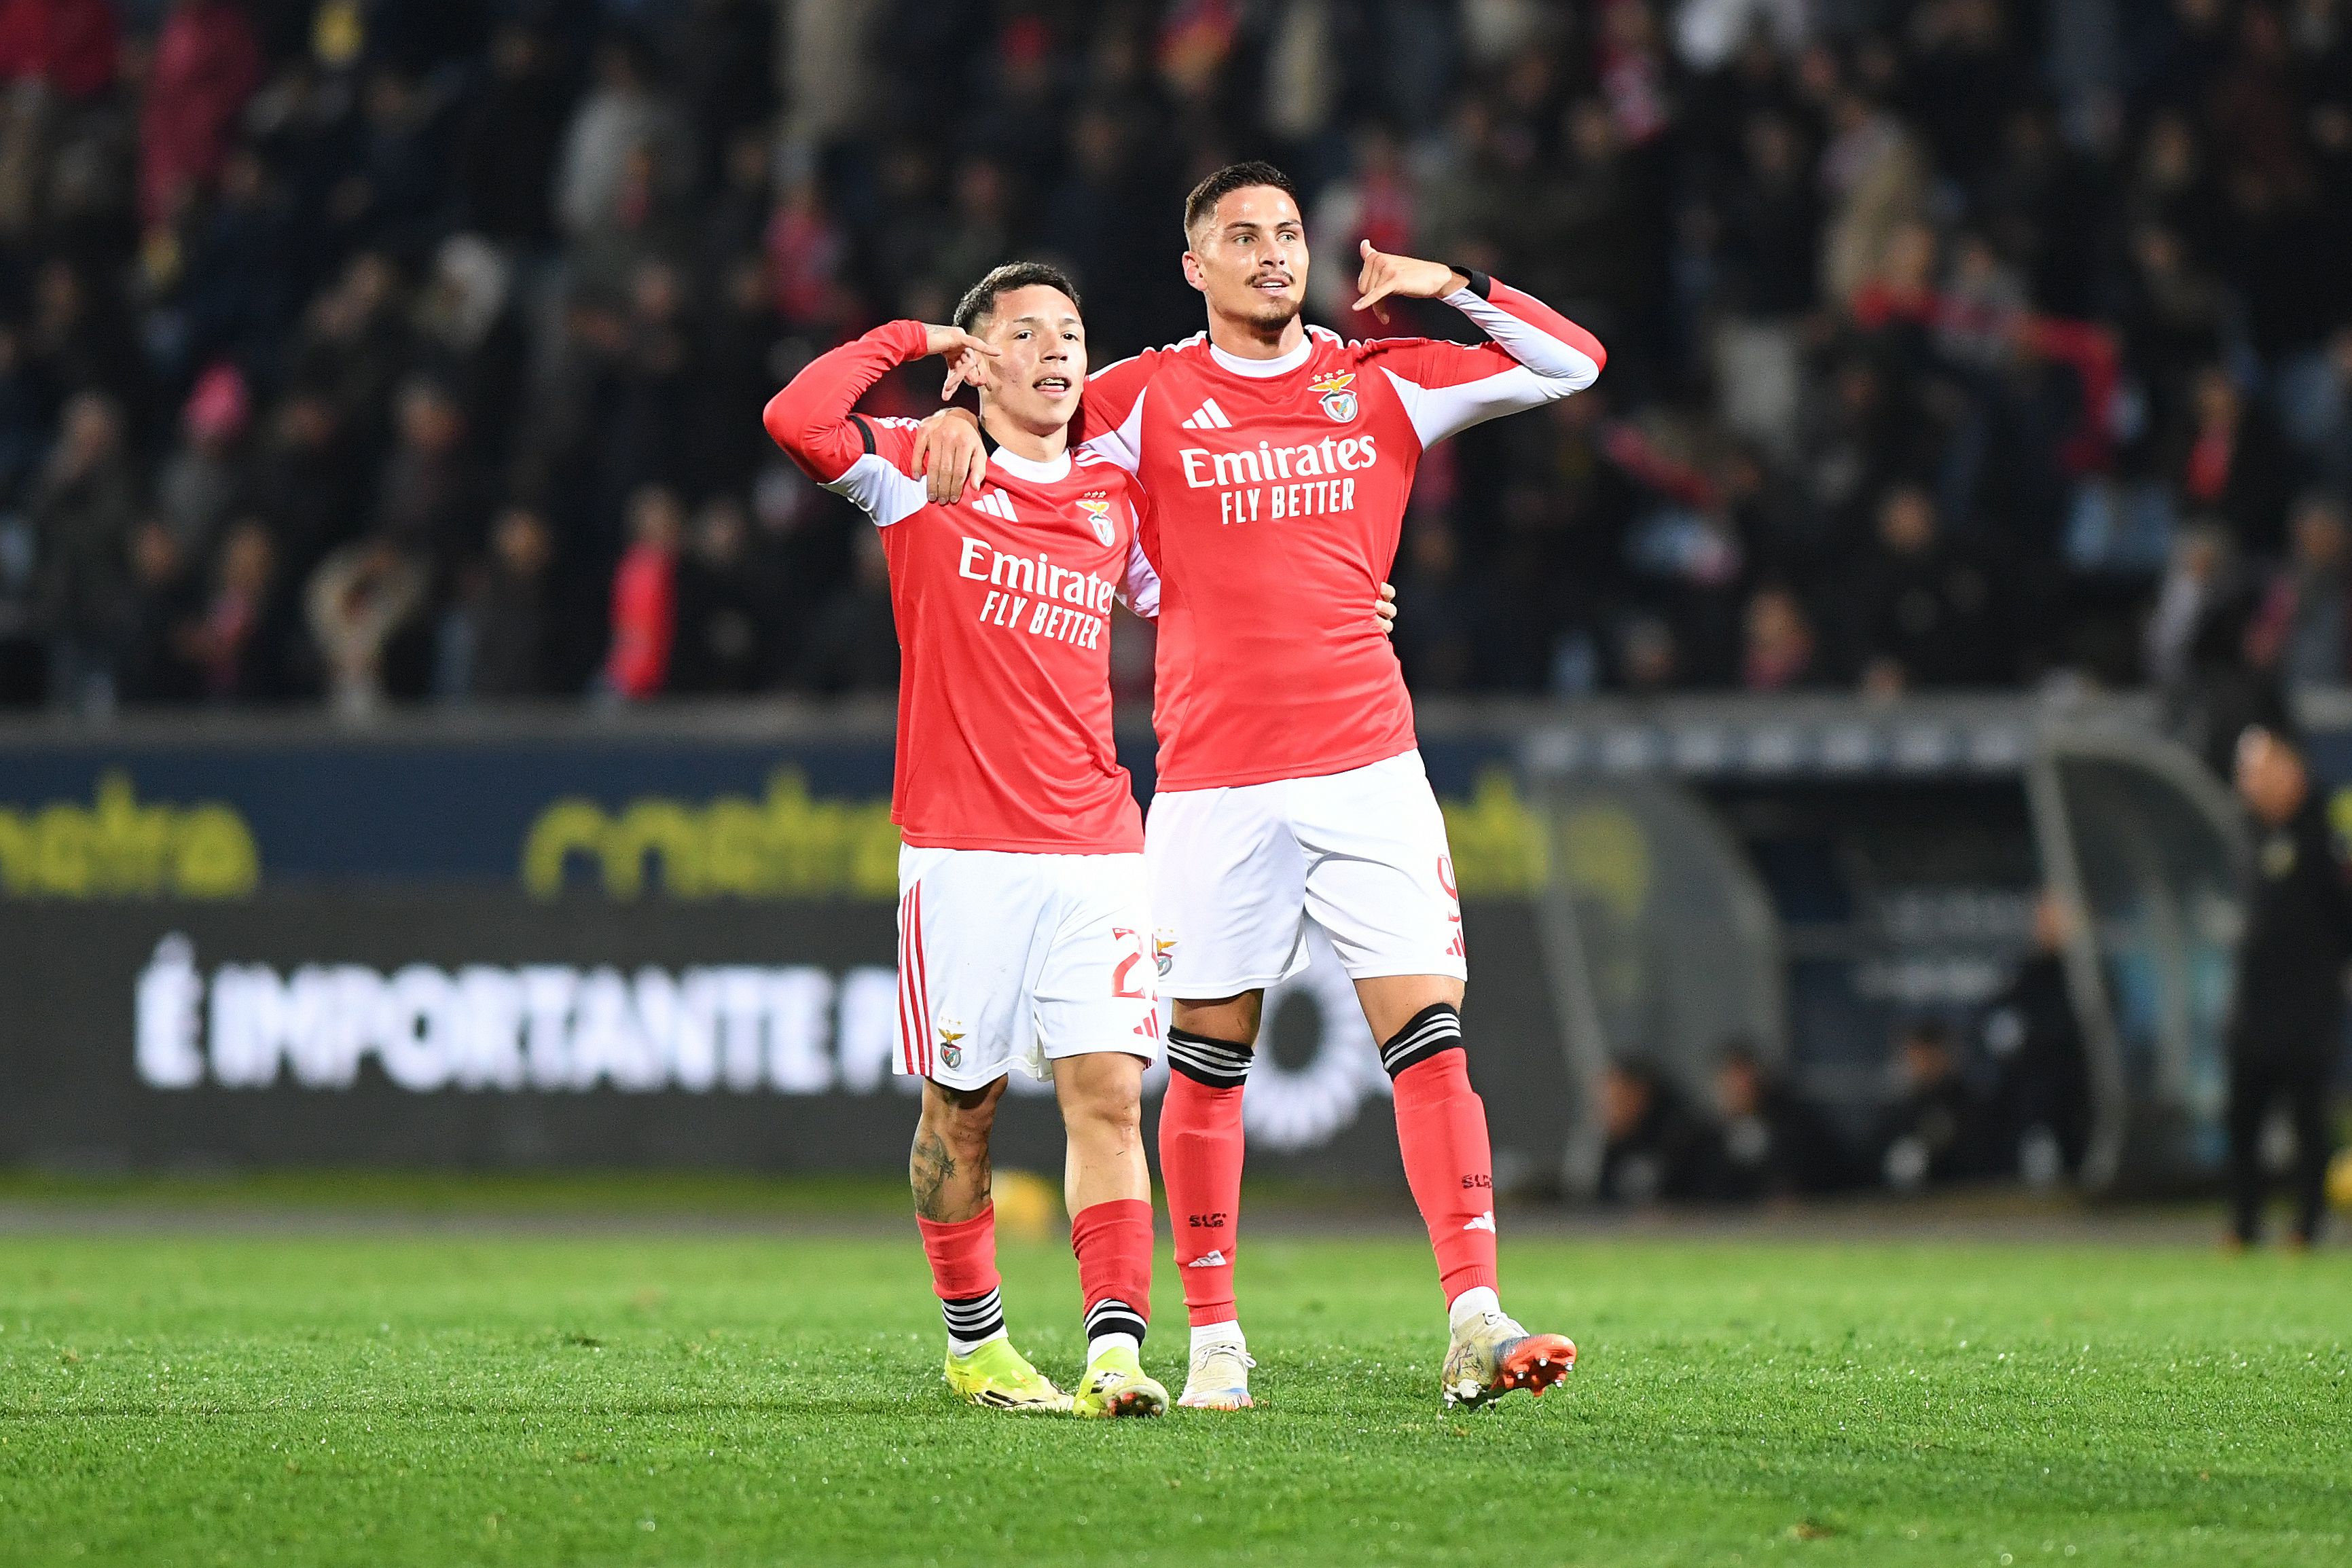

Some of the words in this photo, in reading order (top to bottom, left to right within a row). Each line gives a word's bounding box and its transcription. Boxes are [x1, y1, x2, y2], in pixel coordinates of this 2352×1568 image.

[1178, 435, 1377, 488] Emirates
[1220, 488, 1261, 525] FLY
[1271, 477, 1355, 519] BETTER
[979, 589, 1028, 629] FLY
[1028, 602, 1102, 650] BETTER
[1112, 928, 1159, 1002] 2
[137, 932, 204, 1088] É
[212, 963, 833, 1091] IMPORTANTE
